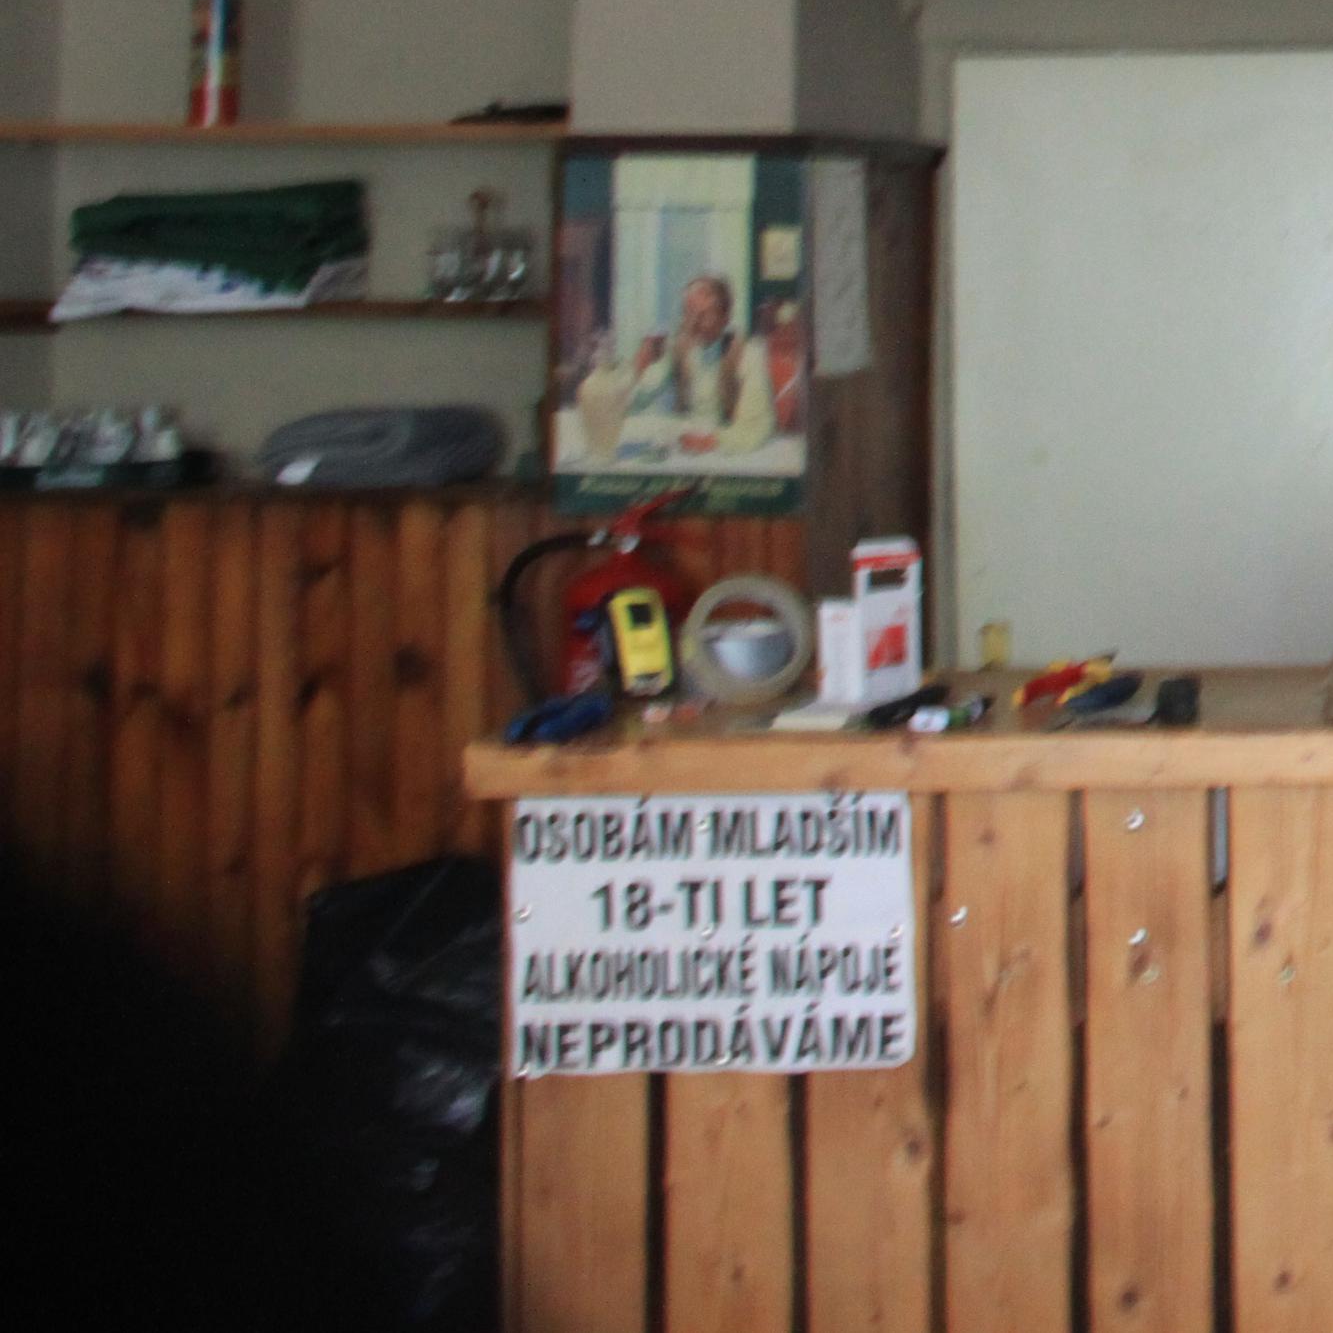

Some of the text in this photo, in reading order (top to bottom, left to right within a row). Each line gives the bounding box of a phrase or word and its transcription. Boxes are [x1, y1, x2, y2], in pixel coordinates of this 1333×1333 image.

[515, 791, 901, 863] OSOBÁM MLADŠÍM
[592, 877, 831, 931] 18-TI LET
[521, 934, 901, 1003] ALKOHOLICKÉ NÁPOJE
[518, 1004, 907, 1066] NEPRODÁVÁME
